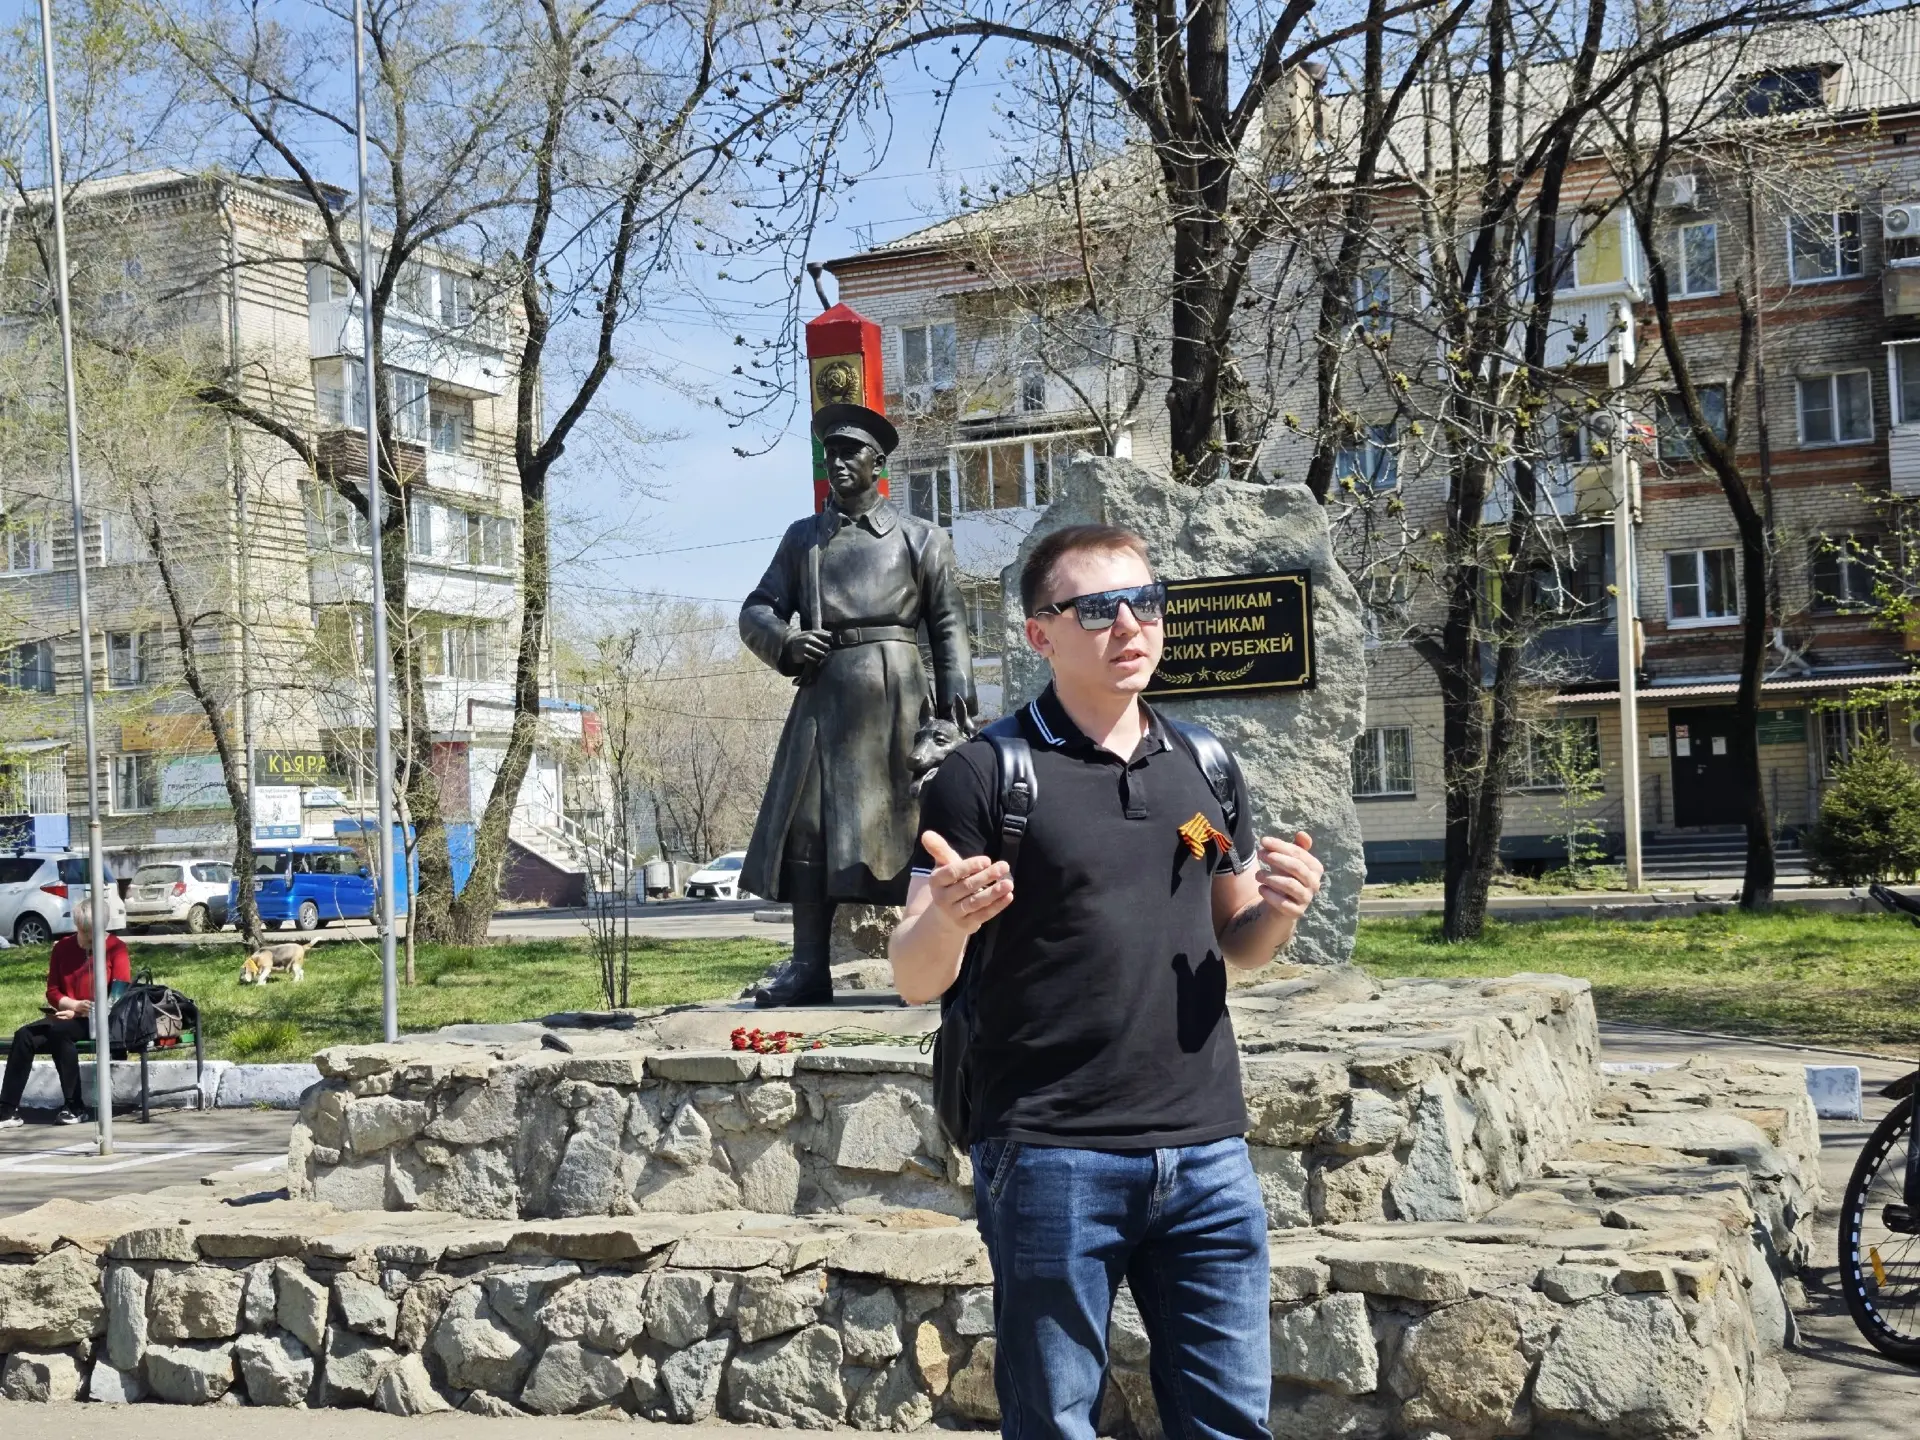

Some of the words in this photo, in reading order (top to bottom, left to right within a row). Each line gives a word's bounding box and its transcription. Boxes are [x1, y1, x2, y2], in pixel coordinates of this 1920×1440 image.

[1165, 591, 1272, 615] АНИЧНИКАМ
[1163, 615, 1265, 640] ЩИТНИКАМ
[1162, 643, 1206, 661] СКИХ
[1210, 632, 1294, 658] РУБЕЖЕЙ
